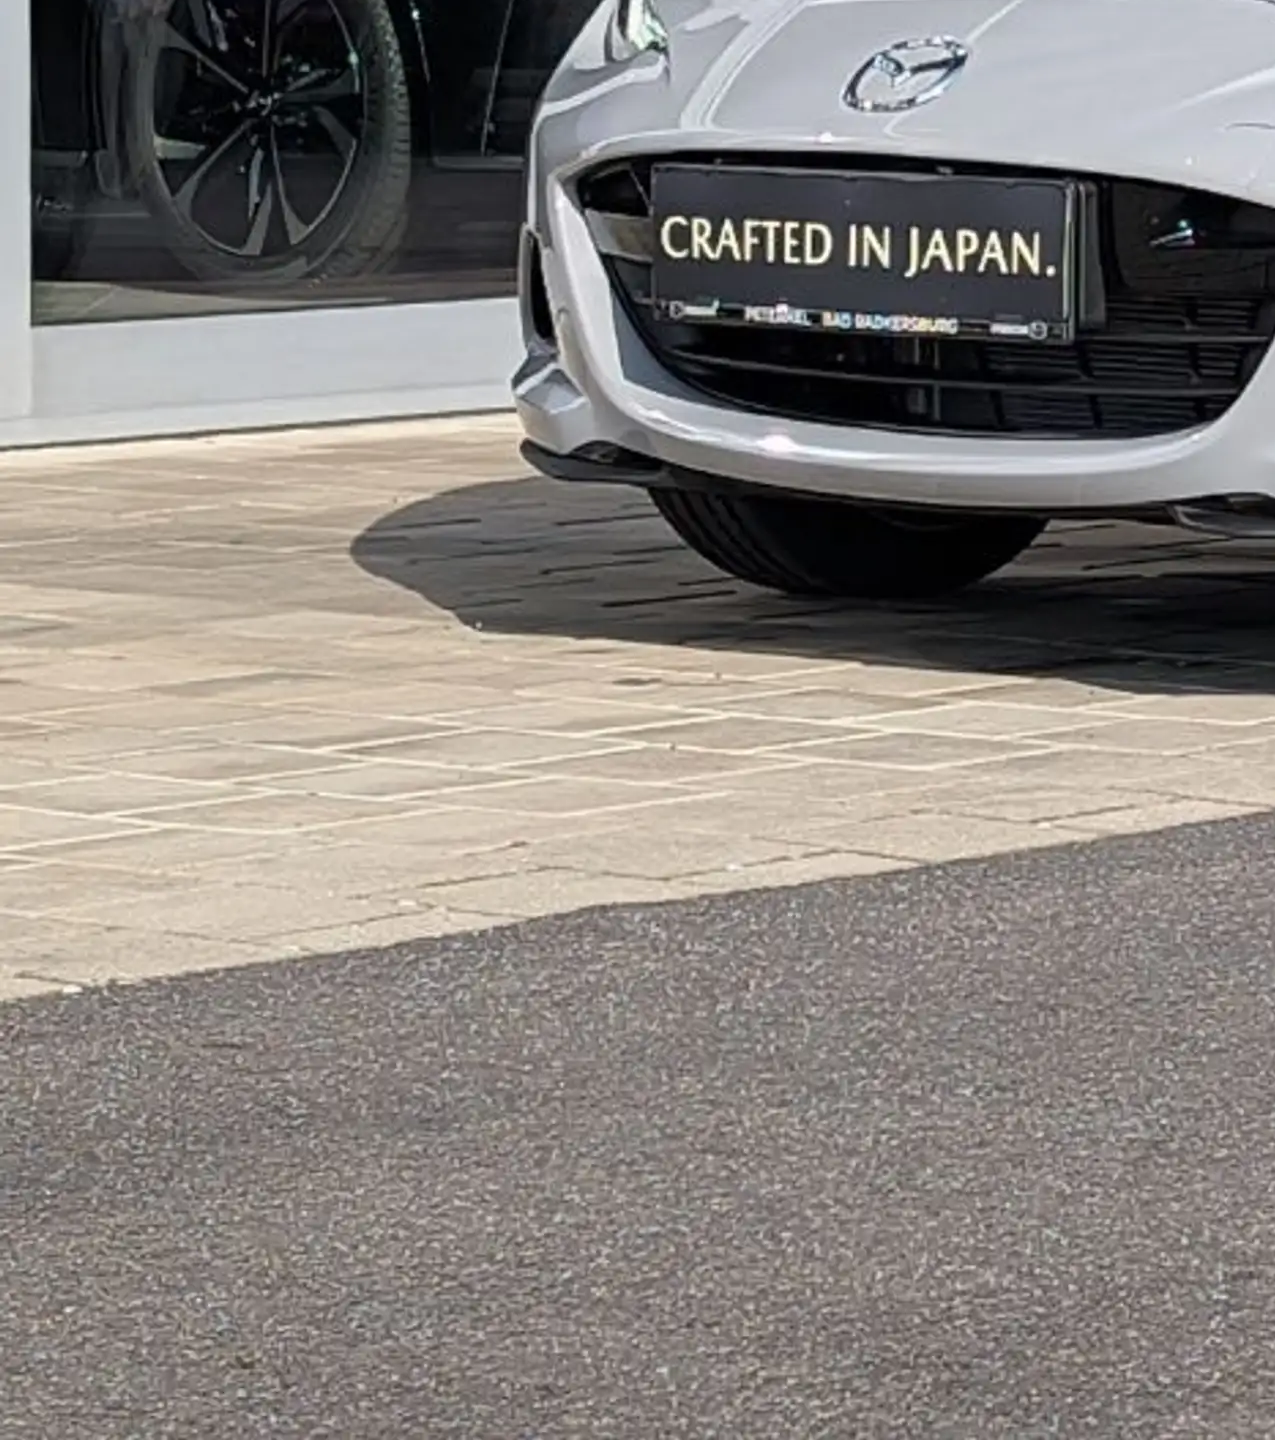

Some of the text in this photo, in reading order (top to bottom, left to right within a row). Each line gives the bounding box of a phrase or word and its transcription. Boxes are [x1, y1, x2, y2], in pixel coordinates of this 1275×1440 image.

[660, 215, 1057, 278] CRAFTED IN JAPAN.
